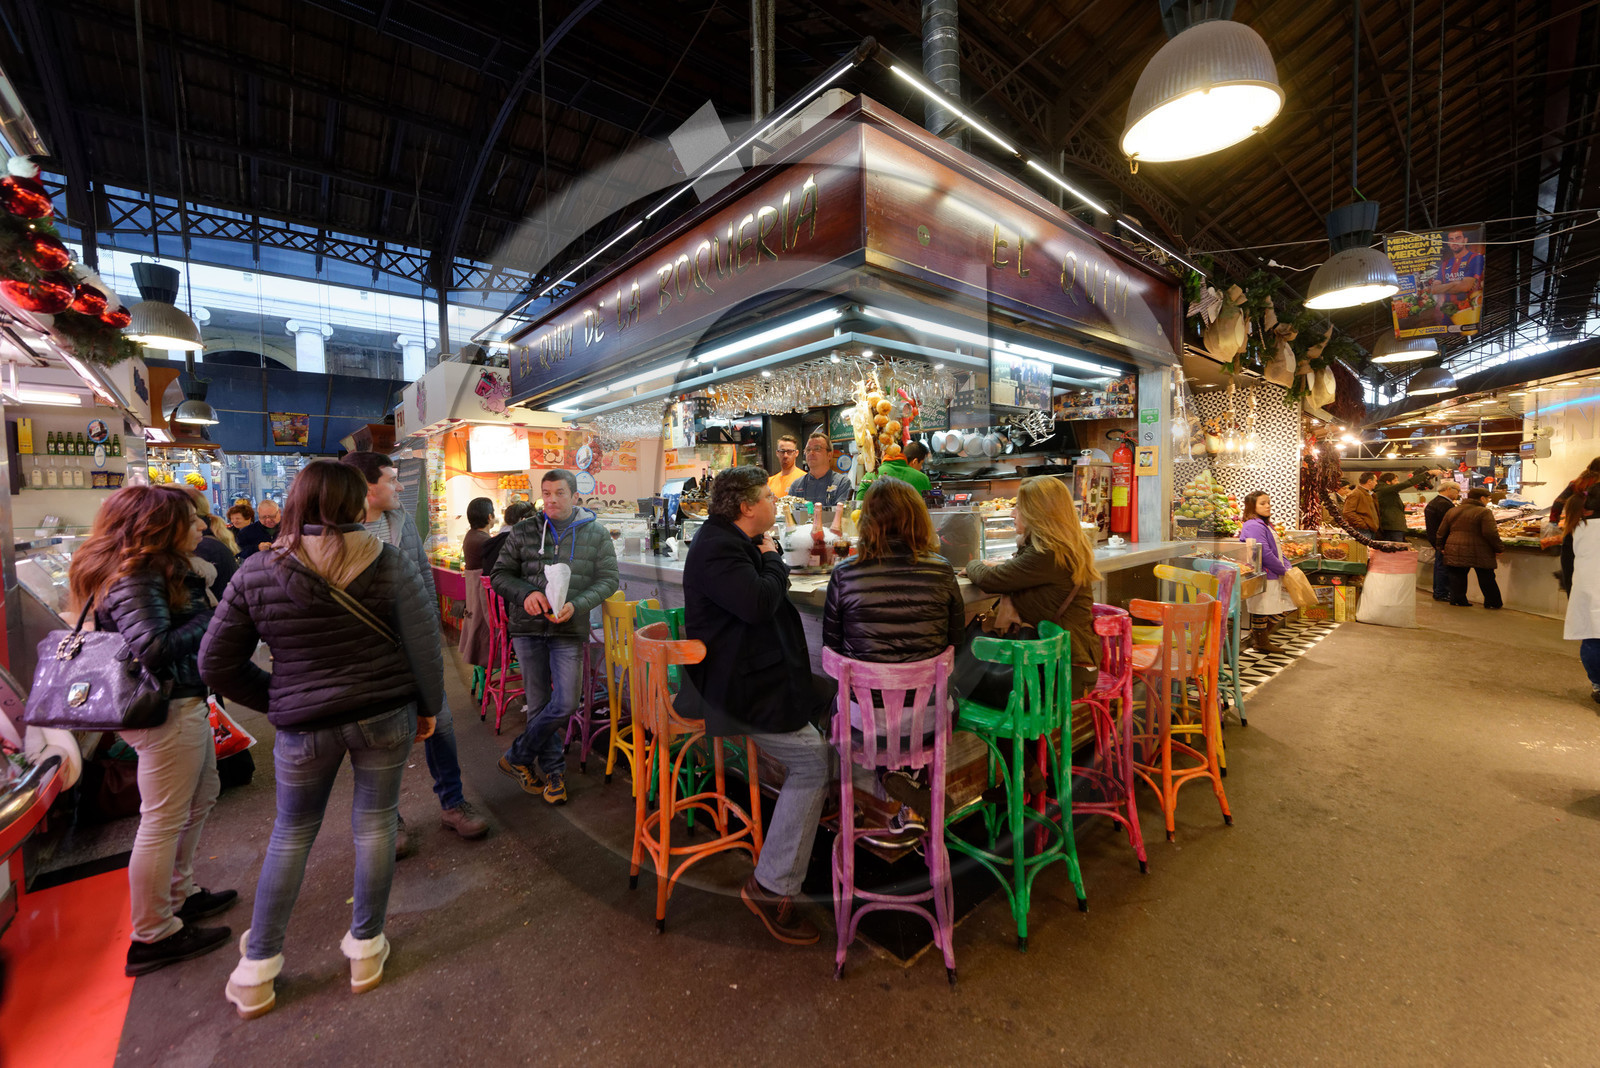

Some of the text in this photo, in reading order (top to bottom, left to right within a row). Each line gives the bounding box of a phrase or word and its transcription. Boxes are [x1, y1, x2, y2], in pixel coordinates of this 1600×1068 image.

[991, 223, 1130, 318] EL QUIM
[1387, 241, 1430, 252] MENGEM
[1387, 246, 1443, 260] MERCAT
[519, 173, 819, 378] EL QUIM DE LA BOQUERIA
